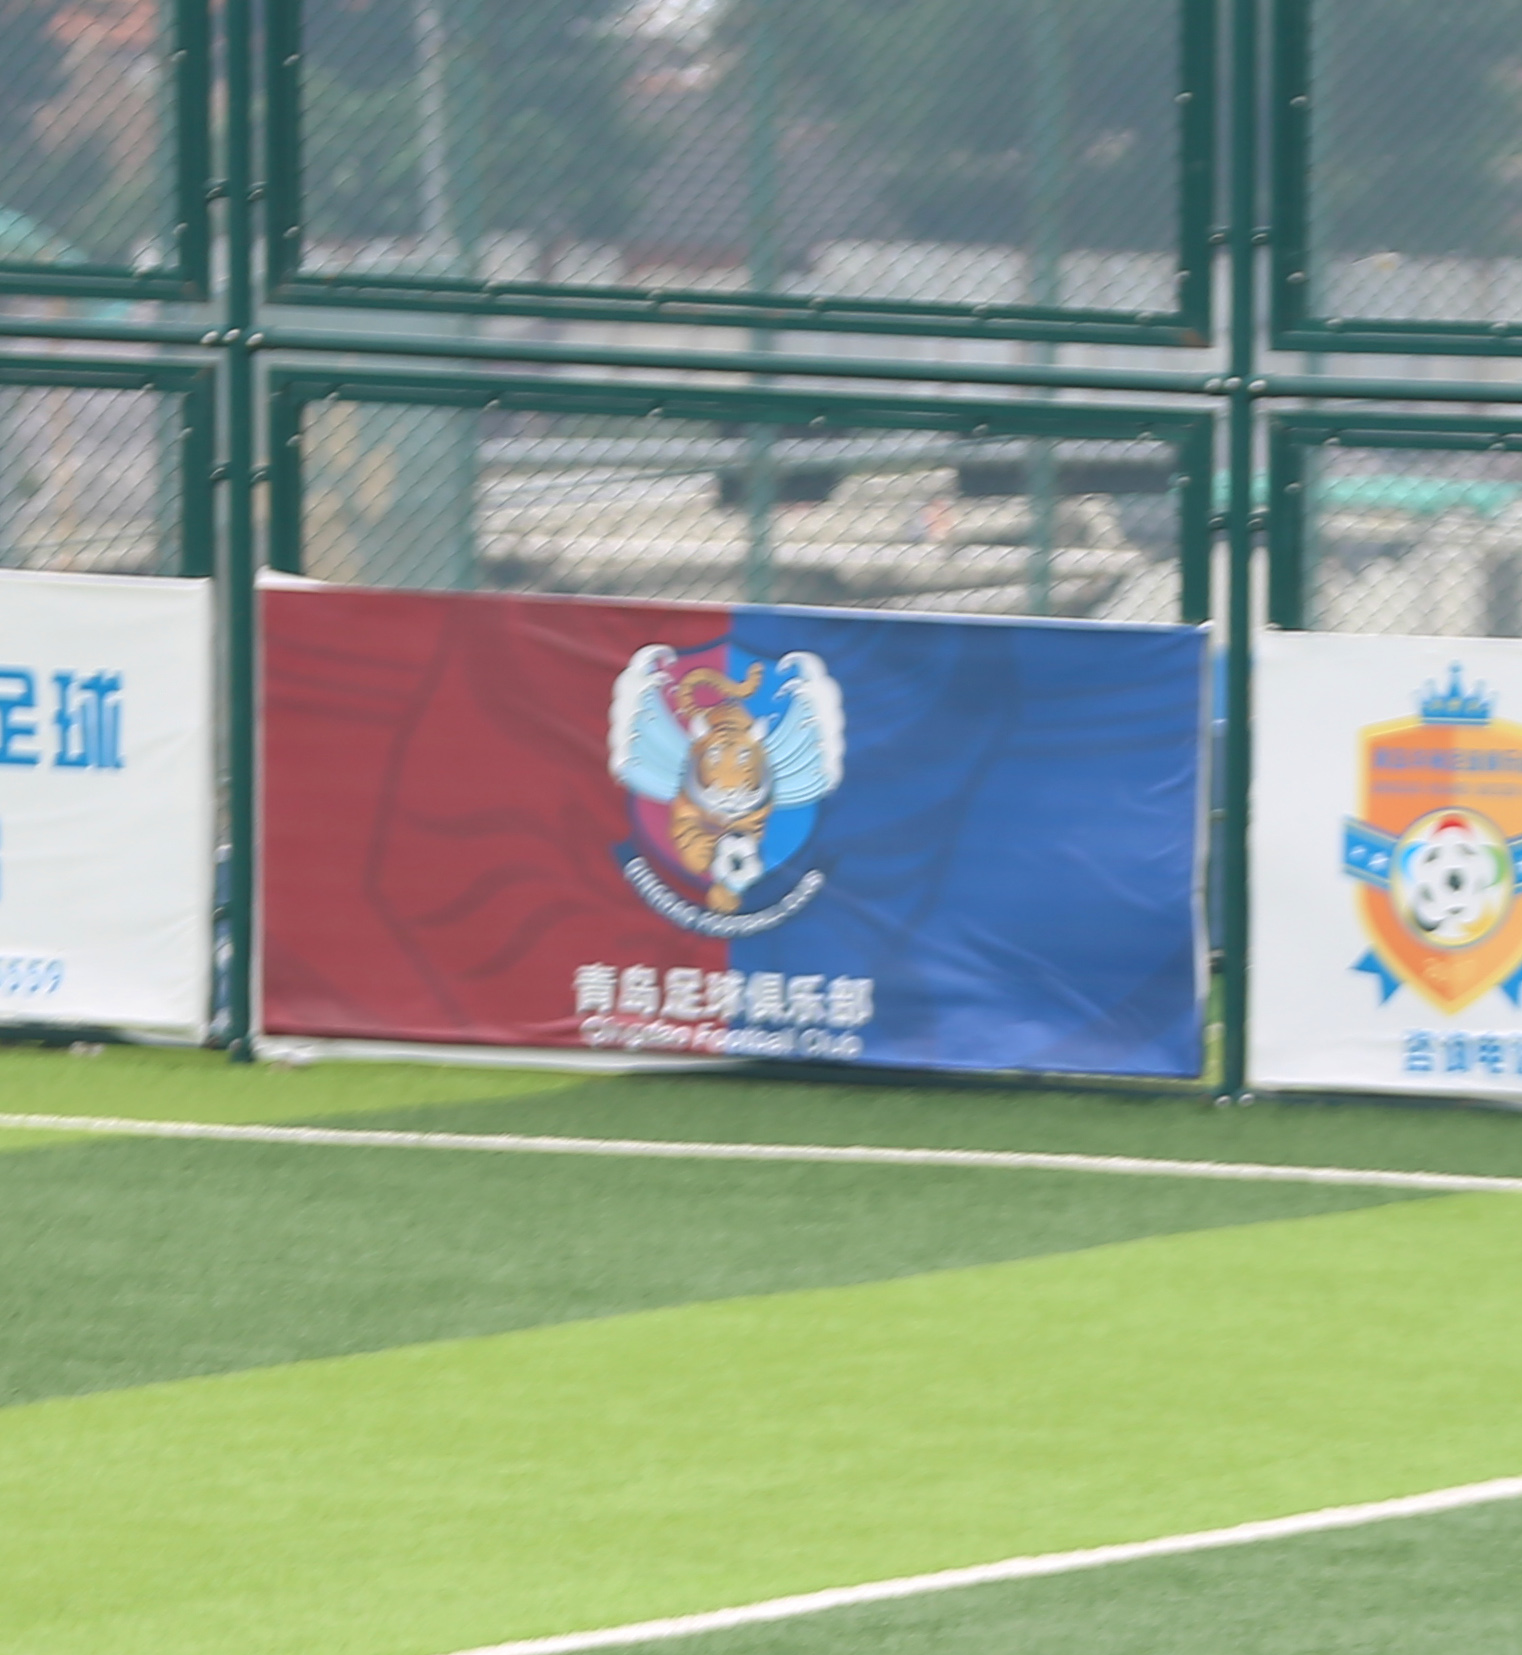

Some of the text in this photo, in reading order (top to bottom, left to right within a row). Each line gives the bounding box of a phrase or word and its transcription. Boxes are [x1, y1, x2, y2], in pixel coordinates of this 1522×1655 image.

[0, 956, 64, 993] 559
[572, 962, 875, 1028] 青岛足球俱乐部
